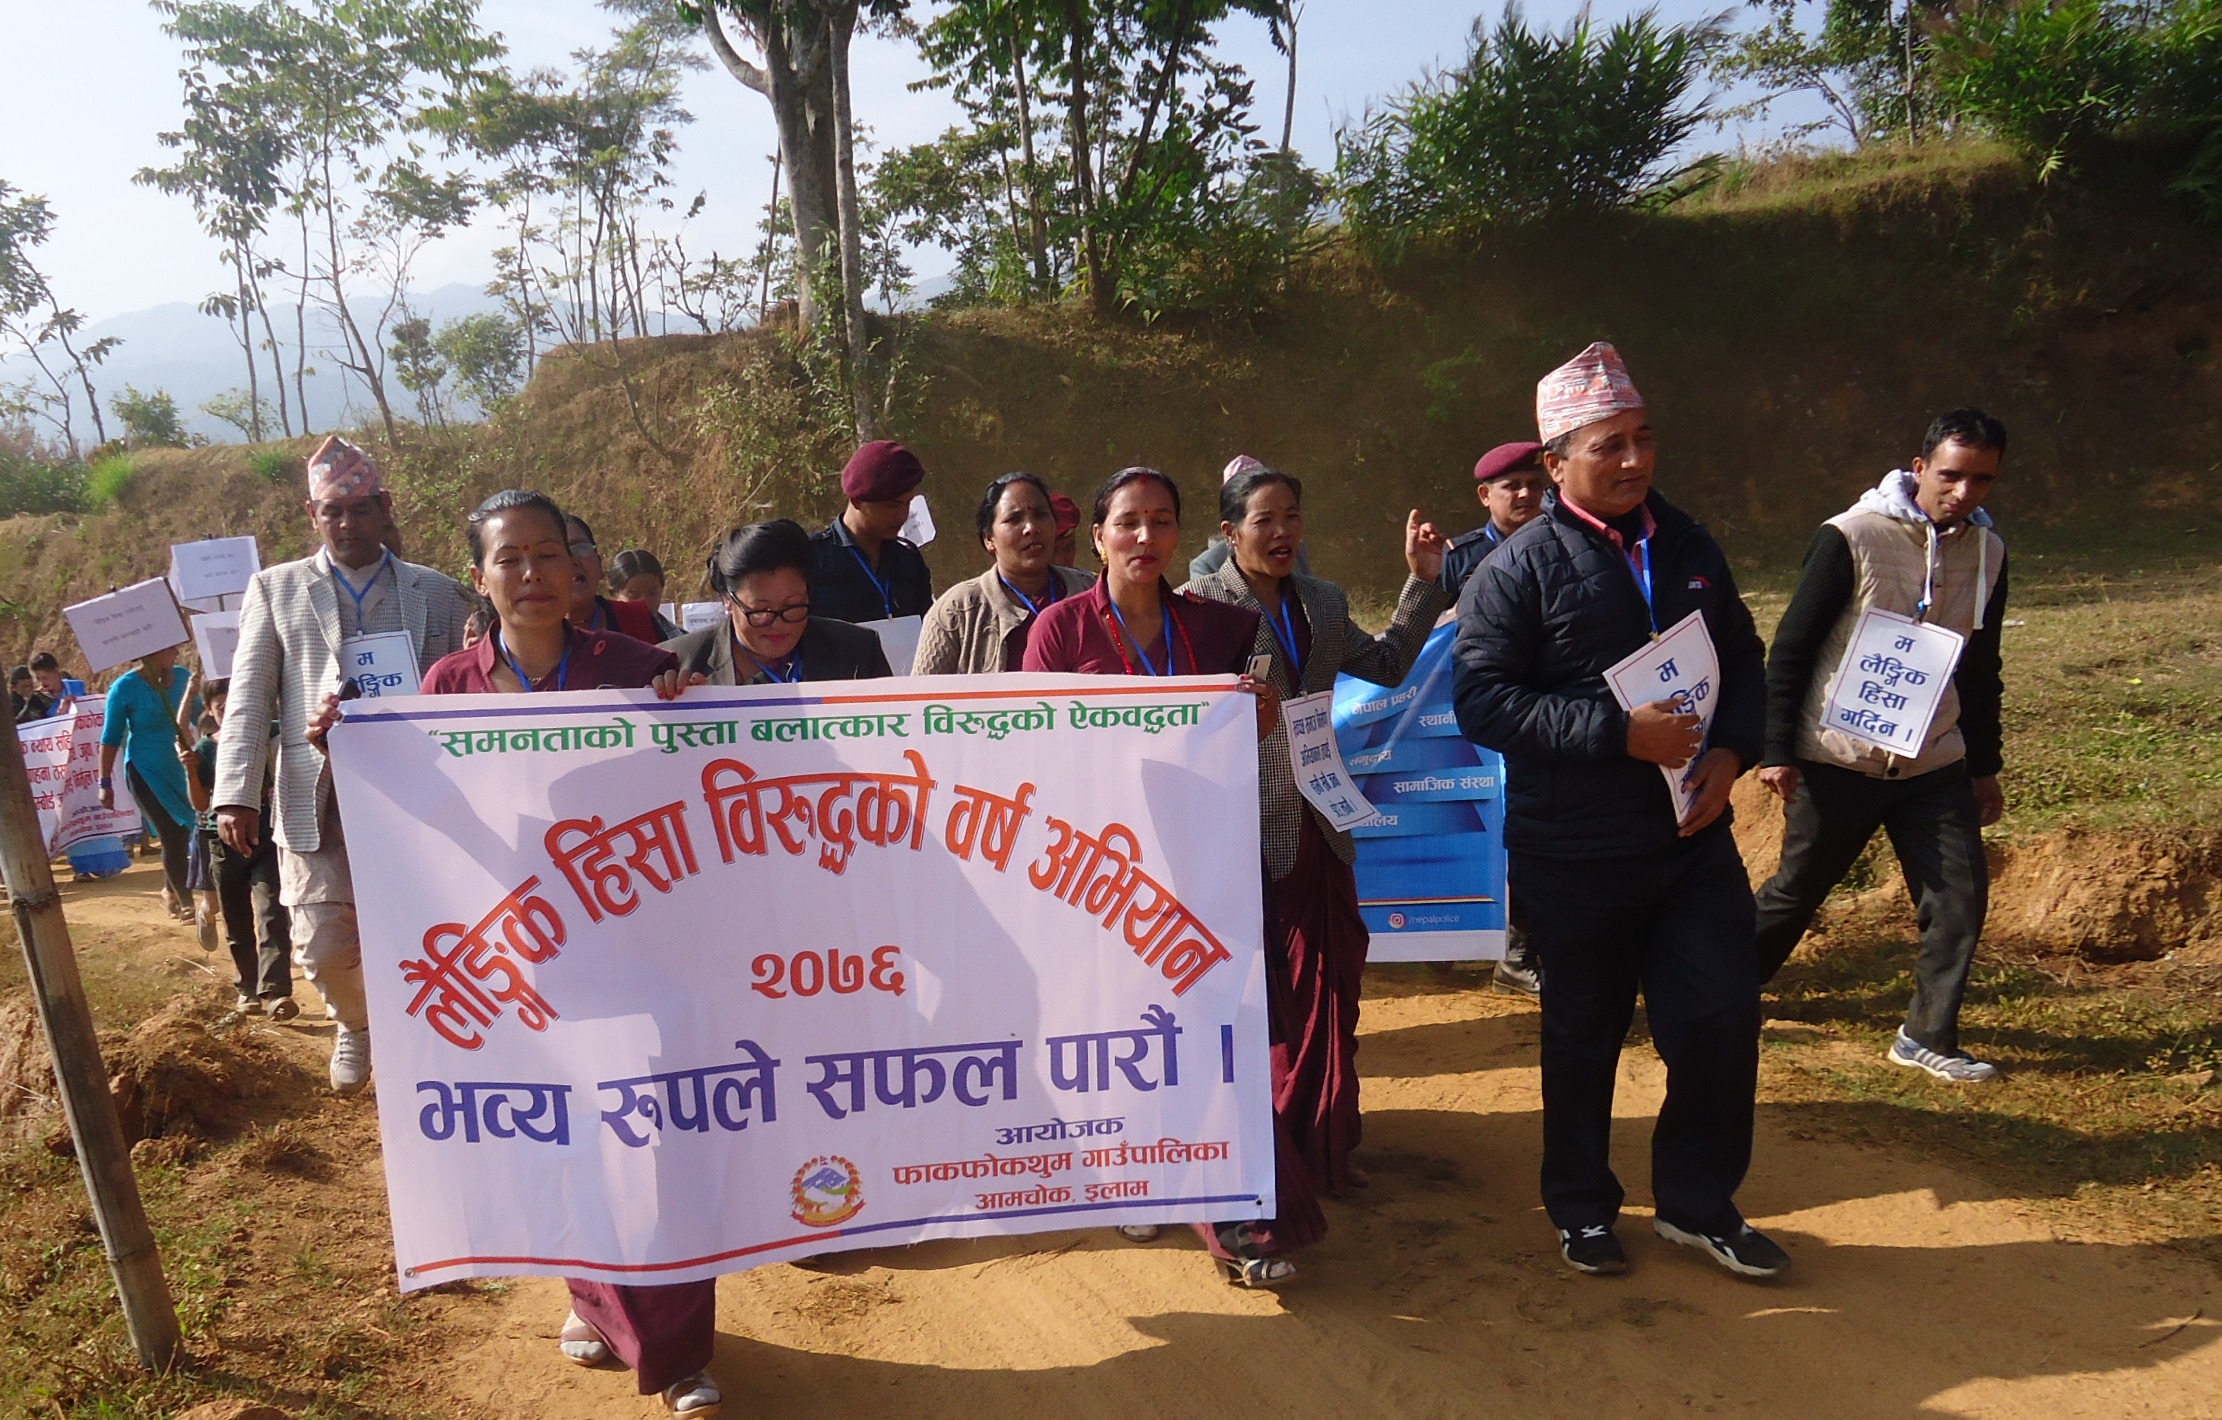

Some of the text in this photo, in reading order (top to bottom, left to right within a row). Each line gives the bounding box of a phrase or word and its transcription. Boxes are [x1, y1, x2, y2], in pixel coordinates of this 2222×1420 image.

[356, 652, 374, 666] म
[1894, 635, 1916, 653] म
[1655, 658, 1679, 683] म
[1860, 653, 1930, 687] लैङ्गिक
[649, 721, 738, 753] पुस्ता
[751, 714, 911, 742] बलात्कार
[1419, 711, 1457, 727] स्थानी
[1393, 775, 1494, 793] सामाजिक संस्था
[398, 874, 567, 1051] लैङ्गिक
[544, 800, 701, 924] हिंसा
[945, 782, 1036, 873] वर्ष
[1028, 815, 1233, 997] अभियान
[751, 945, 906, 999] २०७६
[416, 1080, 572, 1146] भव्य
[597, 1039, 781, 1148] रूपले
[804, 1040, 1023, 1120] सफल
[995, 1116, 1125, 1146] आयोजक
[893, 1138, 1229, 1185] फाकफोकथुम गाउँपालिका
[1084, 1180, 1150, 1202] इलाम
